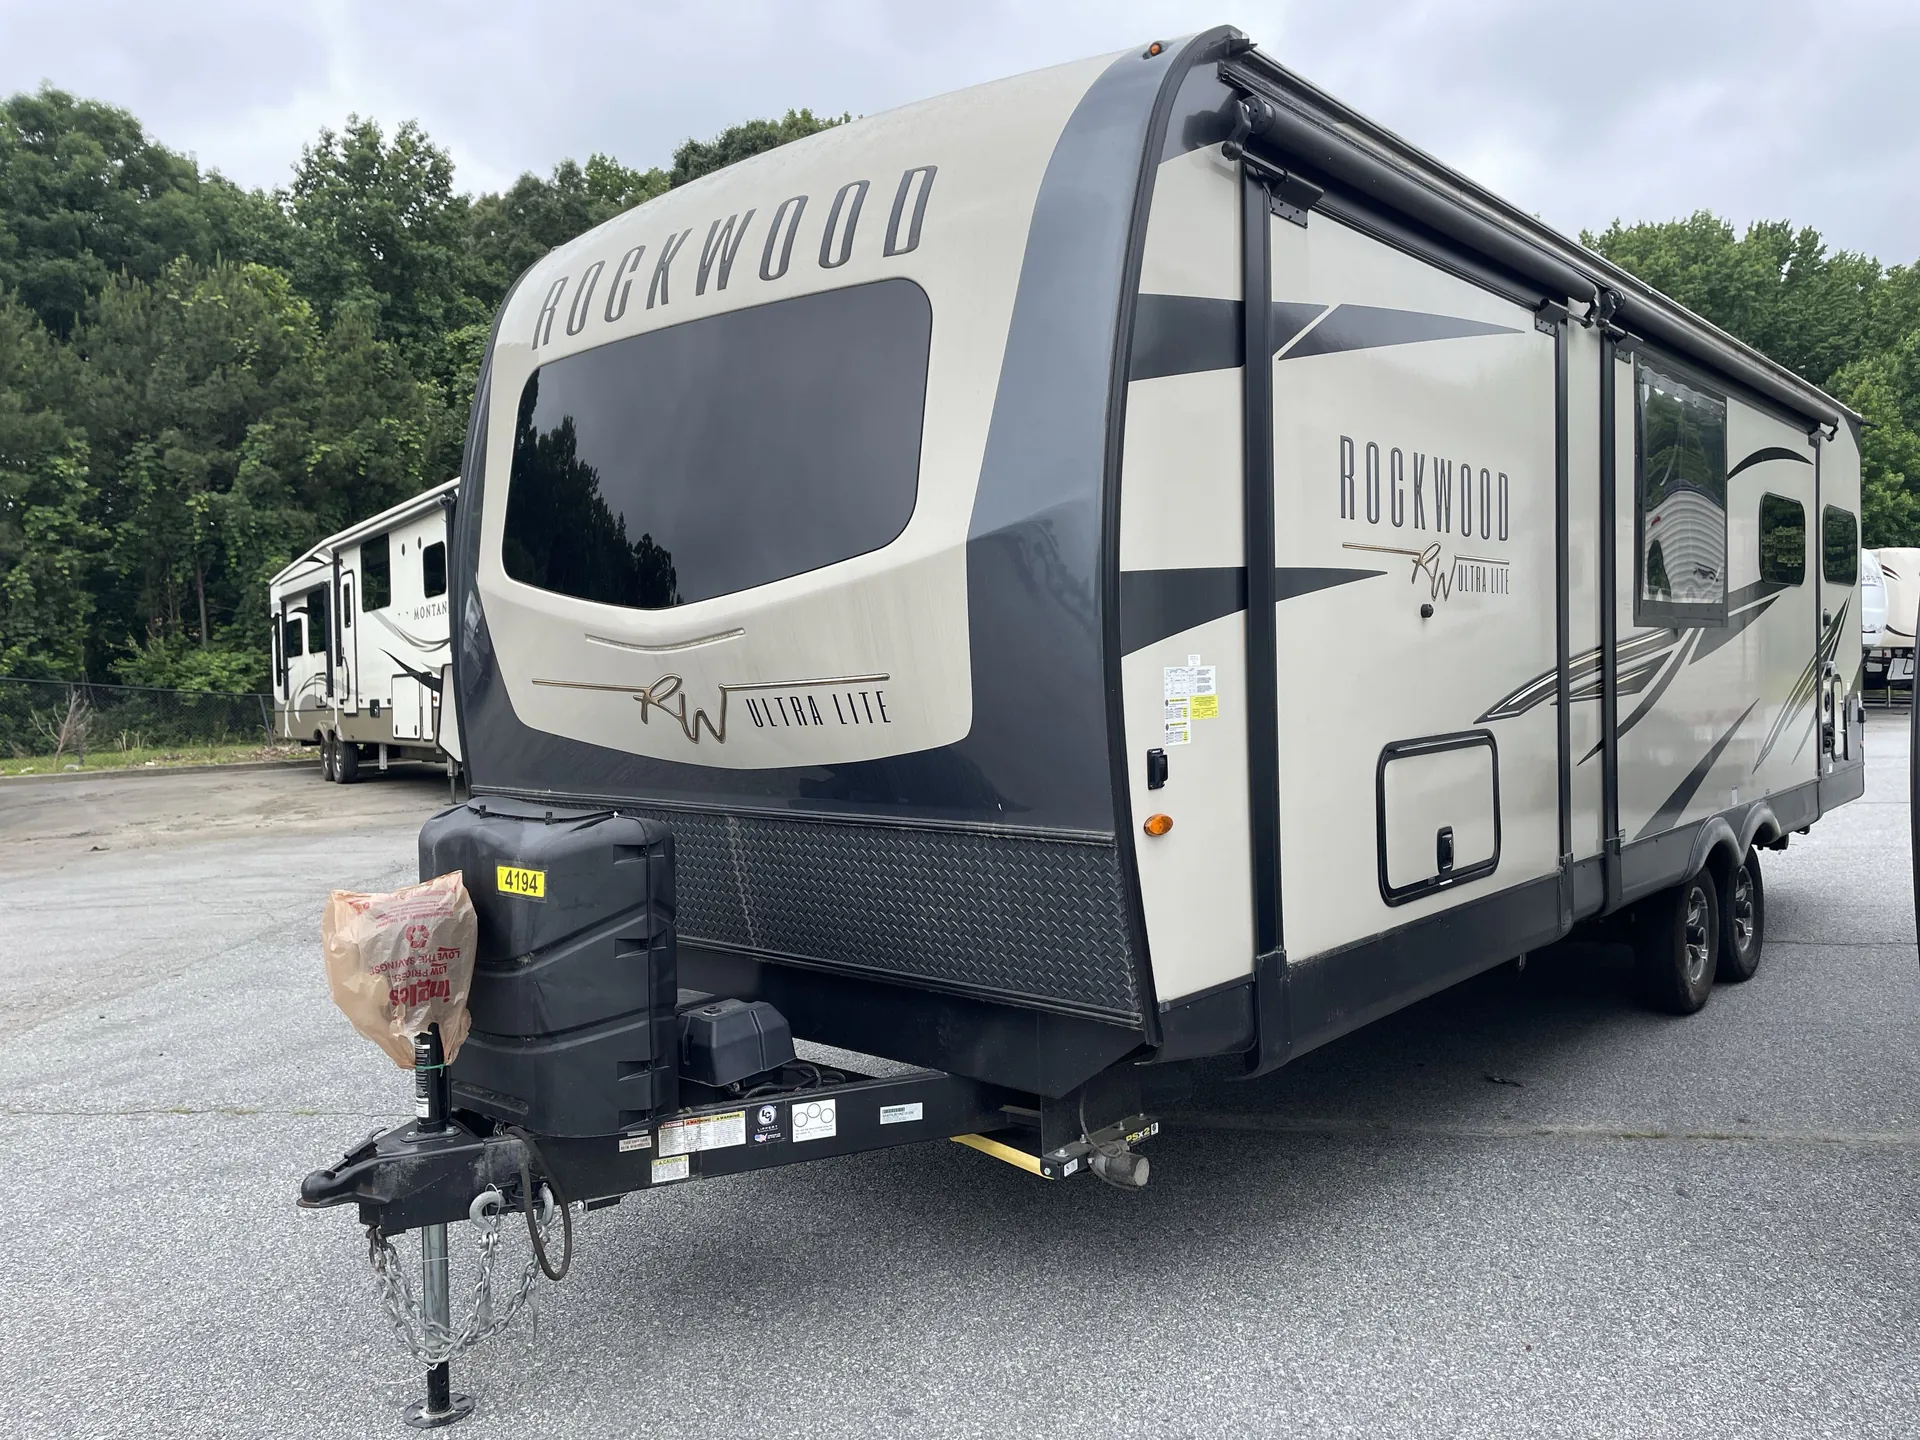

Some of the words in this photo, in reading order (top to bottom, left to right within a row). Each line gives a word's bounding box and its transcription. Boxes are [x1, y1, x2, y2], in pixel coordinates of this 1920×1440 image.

[532, 165, 938, 351] ROCKWOOD
[1340, 435, 1509, 542] ROCKWOOD
[1458, 564, 1487, 593] ULTRA
[1491, 567, 1509, 595] LITE
[746, 696, 824, 728] ULTRA
[832, 690, 891, 725] LITE
[505, 869, 538, 894] 4194
[418, 953, 437, 964] THE
[436, 950, 460, 960] LOVE
[430, 965, 447, 976] LOW
[389, 979, 450, 1007] ingles
